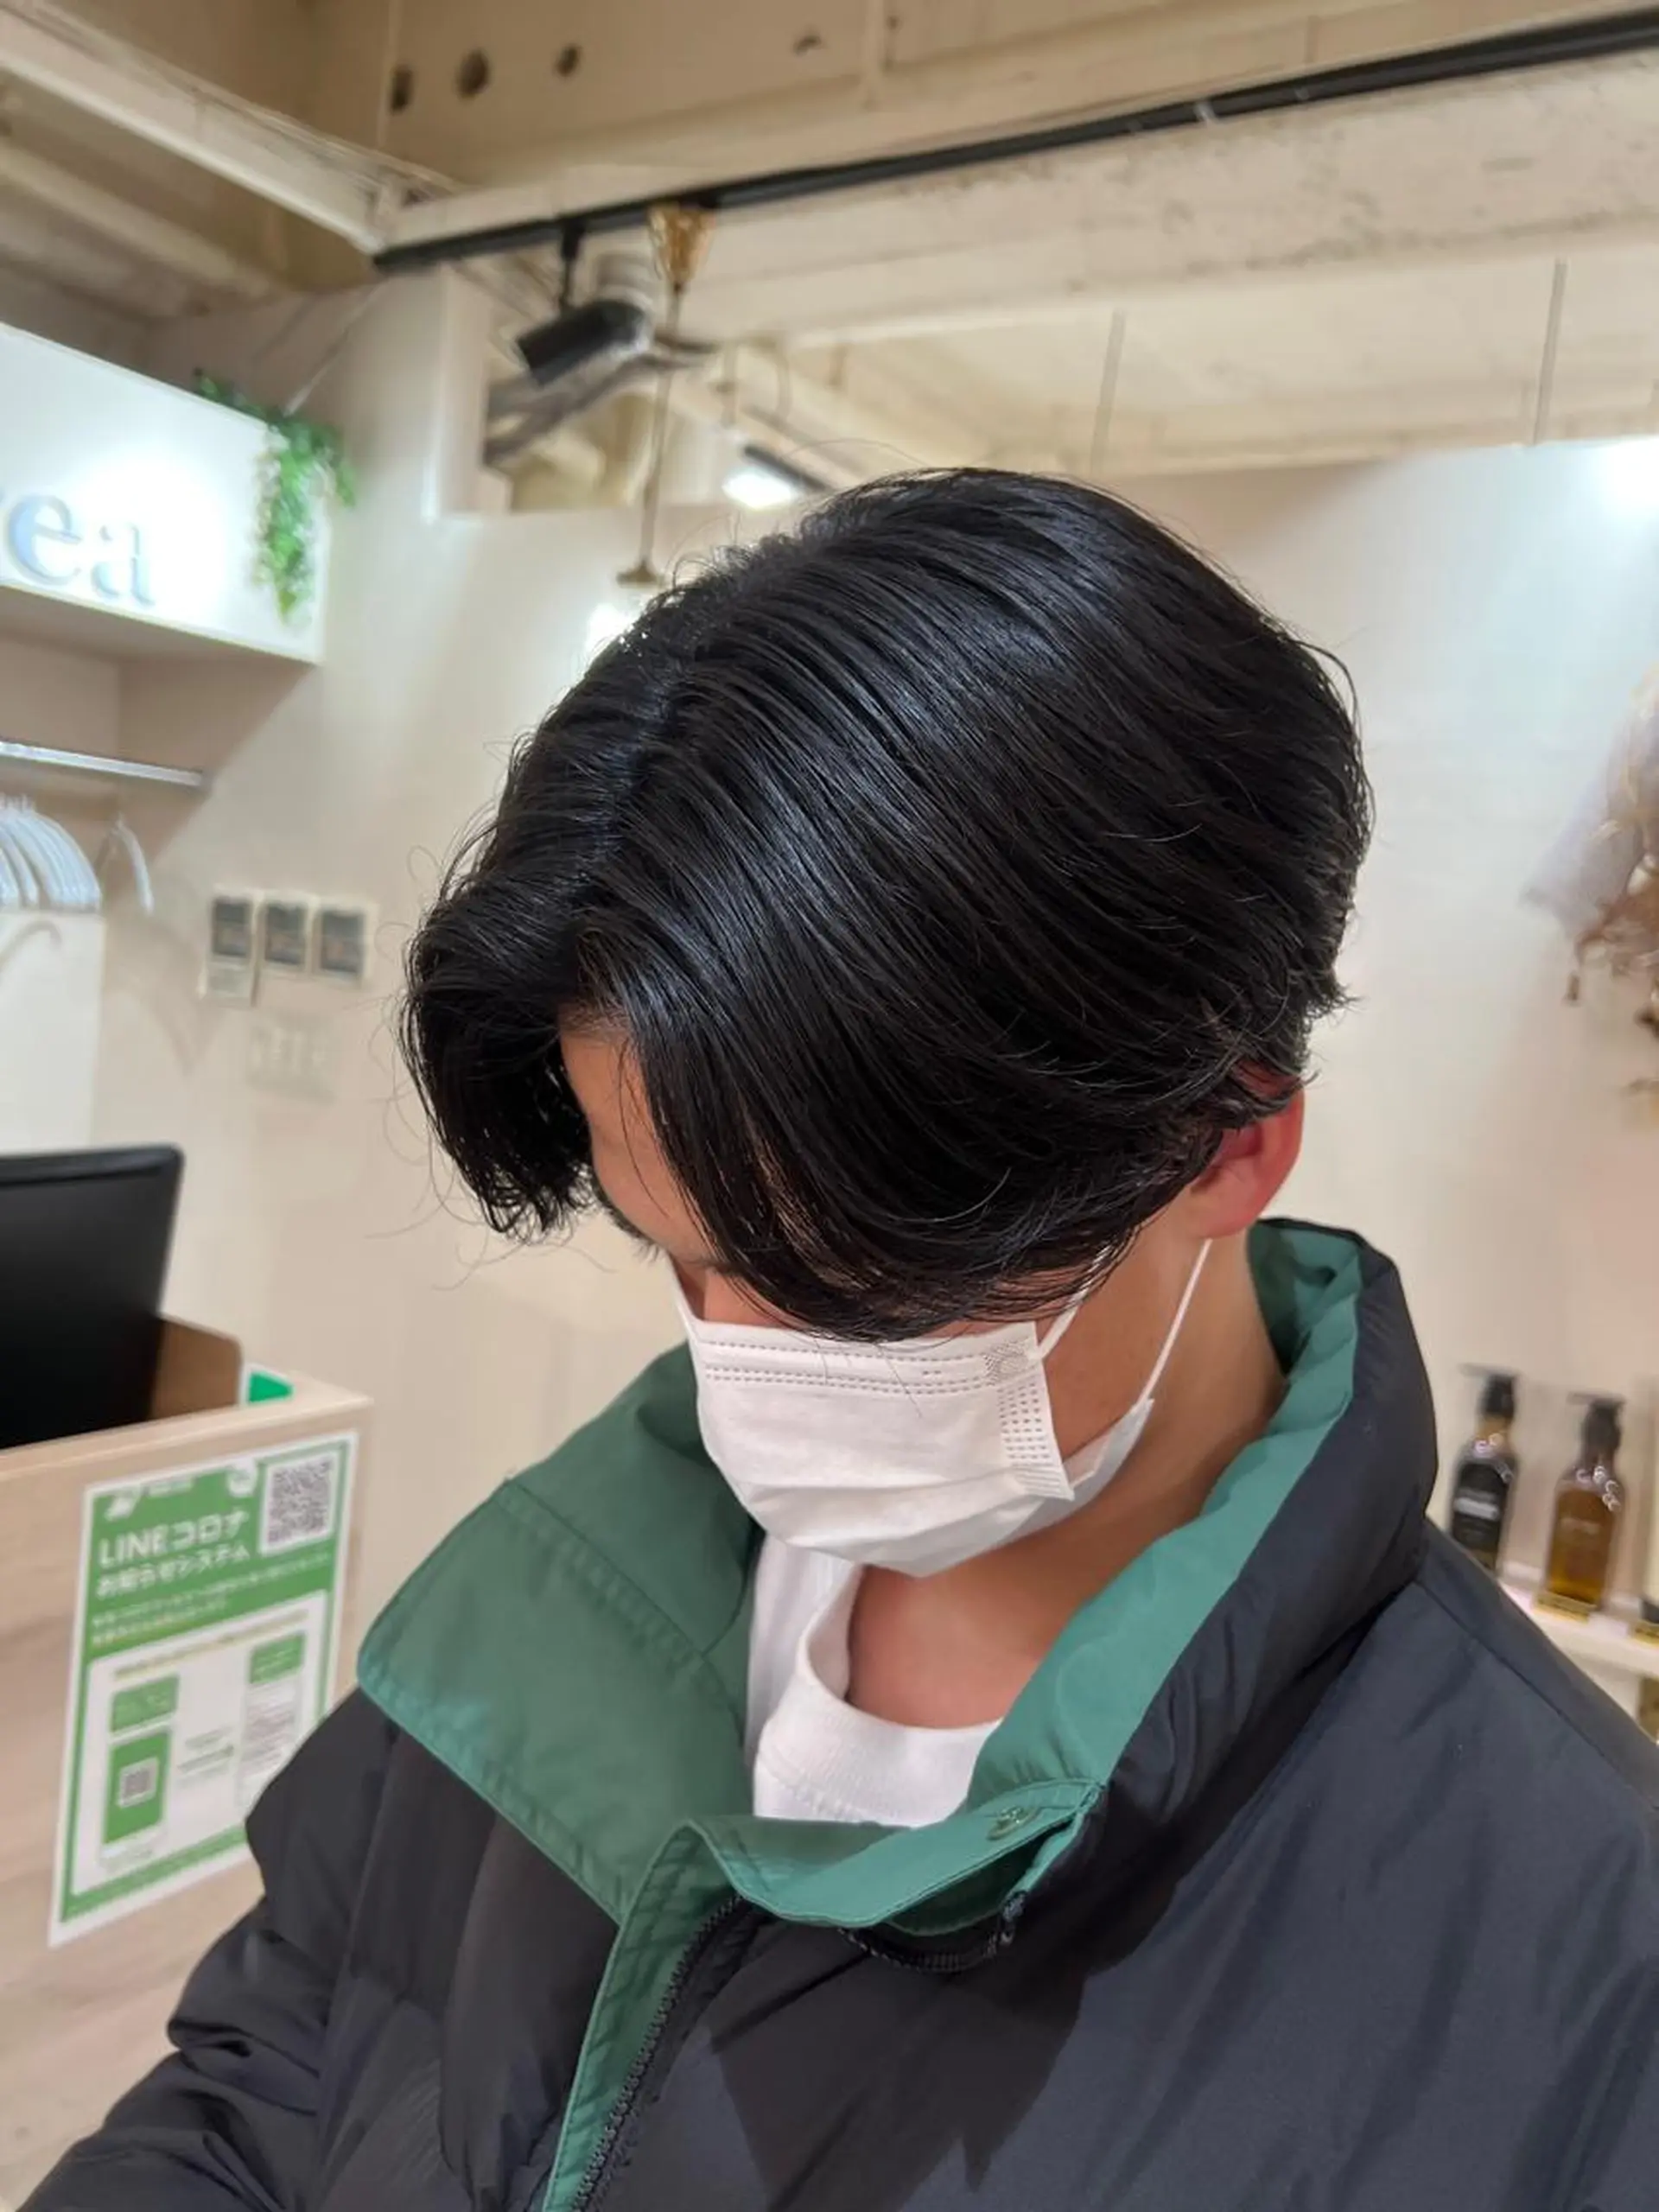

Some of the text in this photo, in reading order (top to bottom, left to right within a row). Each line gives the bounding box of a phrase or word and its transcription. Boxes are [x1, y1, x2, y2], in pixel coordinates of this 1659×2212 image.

[0, 488, 156, 607] ea
[98, 1509, 250, 1568] LINEコロナ
